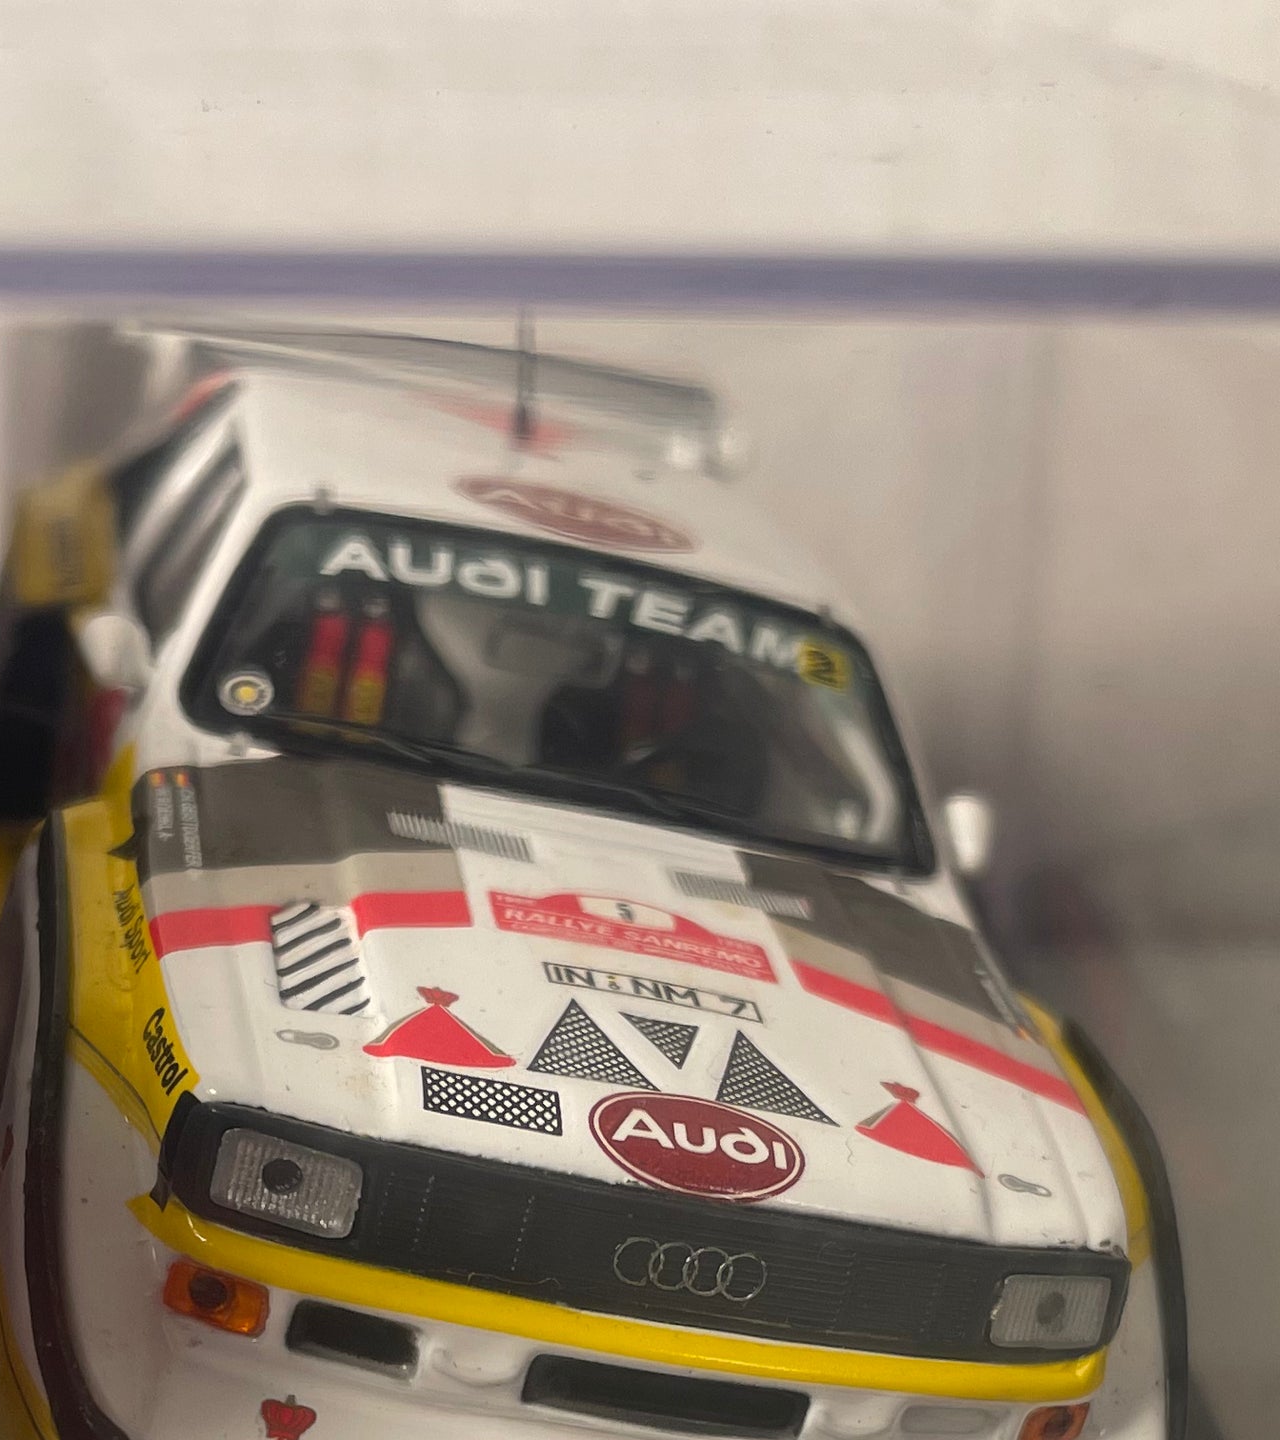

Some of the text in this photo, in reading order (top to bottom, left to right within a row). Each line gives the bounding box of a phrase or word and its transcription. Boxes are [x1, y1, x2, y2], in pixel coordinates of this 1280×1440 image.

[578, 576, 804, 668] TEAM
[504, 908, 614, 935] RALLYE
[624, 930, 762, 968] SANREMO
[142, 1007, 189, 1096] Castrol
